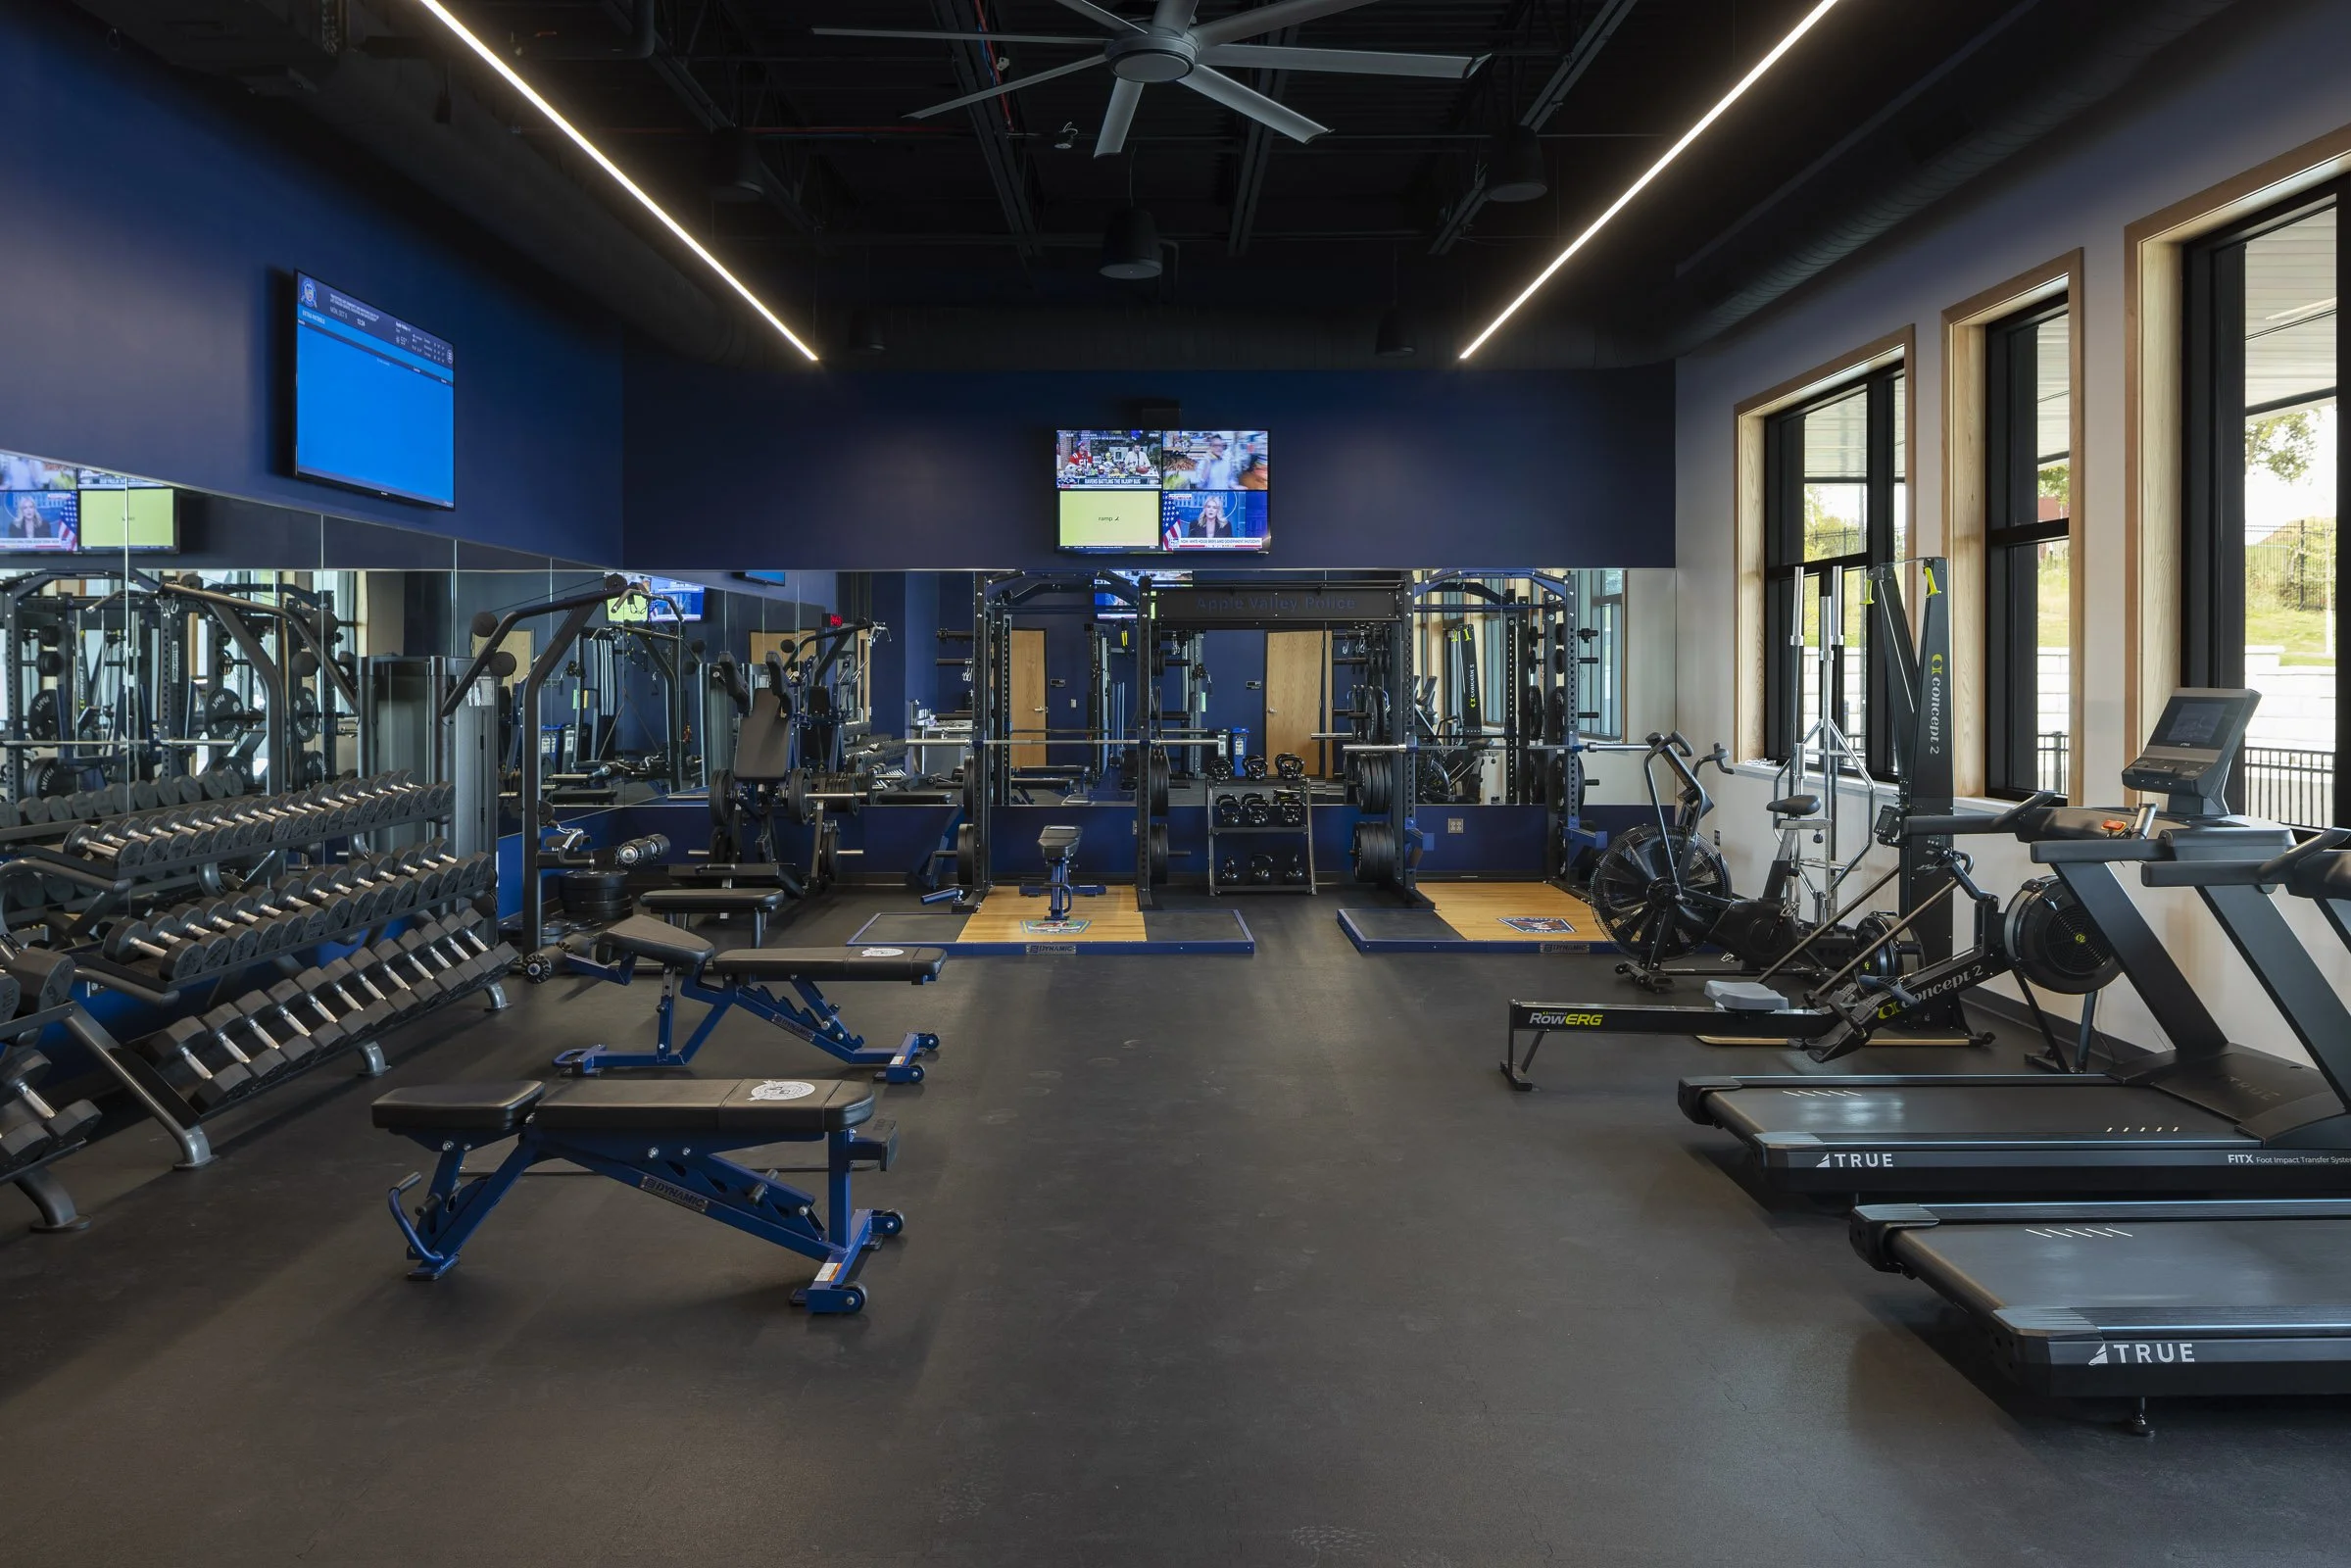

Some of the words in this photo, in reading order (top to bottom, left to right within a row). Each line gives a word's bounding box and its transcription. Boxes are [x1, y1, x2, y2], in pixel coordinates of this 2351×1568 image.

[1197, 596, 1244, 612] Apple
[1249, 596, 1298, 612] Valley
[1304, 596, 1356, 610] Police
[1929, 677, 1940, 743] concept
[1930, 746, 1940, 755] 2
[1972, 964, 1984, 976] 2
[1834, 1152, 1893, 1168] TRUE
[2228, 1153, 2254, 1164] FITX
[656, 1181, 705, 1207] DYNAMIC
[2113, 1343, 2195, 1363] TRUE
